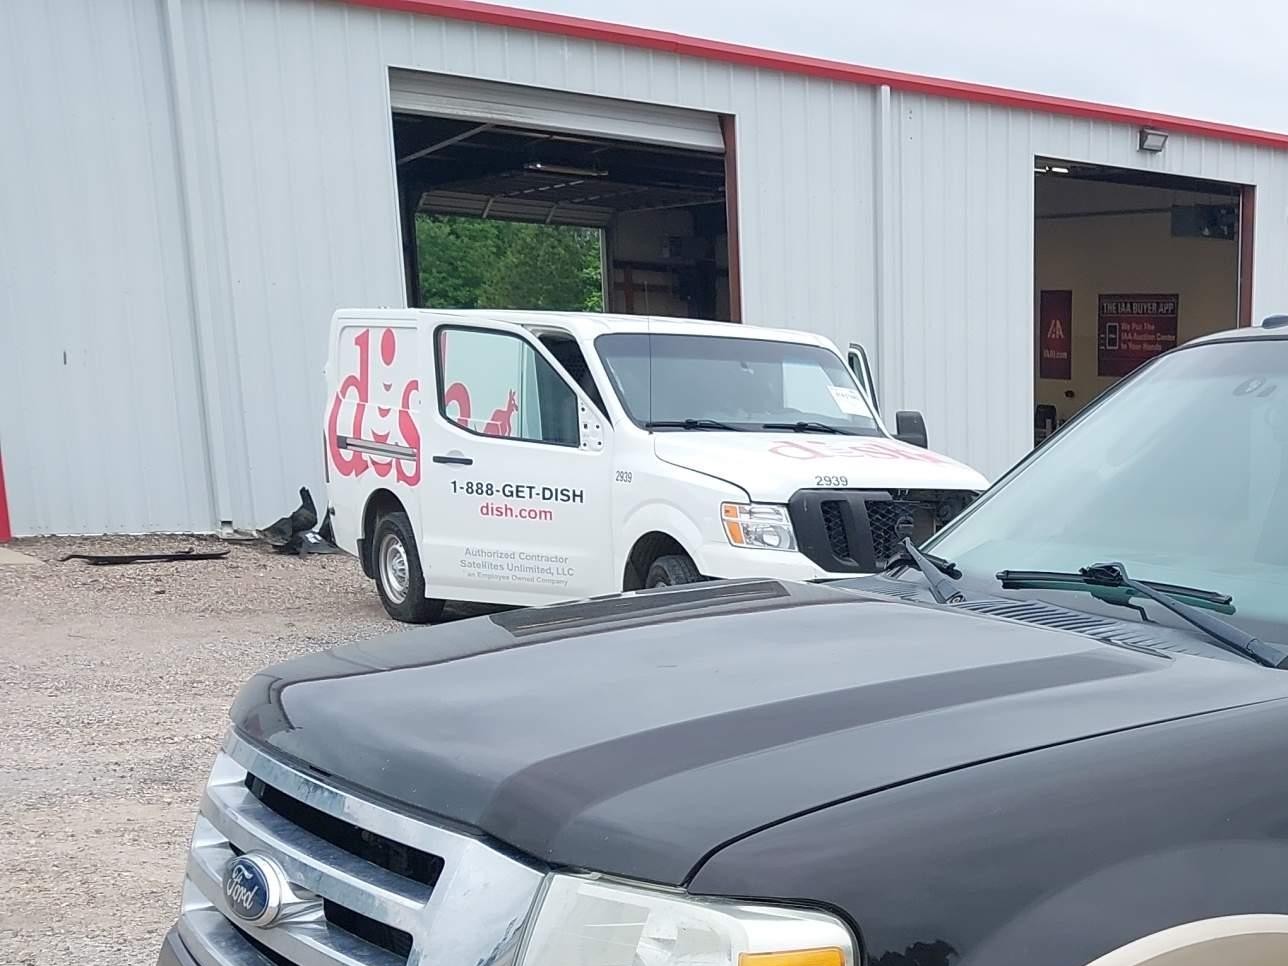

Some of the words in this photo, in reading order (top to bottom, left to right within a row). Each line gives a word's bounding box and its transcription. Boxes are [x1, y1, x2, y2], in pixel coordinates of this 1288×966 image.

[1104, 303, 1117, 313] THE
[1118, 303, 1131, 313] IAA
[1132, 303, 1157, 313] BUYER
[1158, 303, 1174, 313] APP
[615, 470, 633, 483] 2939
[815, 475, 848, 487] 2939
[451, 480, 584, 503] 1-888-GET-DISH
[480, 503, 553, 521] dish.com
[464, 547, 516, 560] Authorized
[518, 551, 569, 564] Contractor
[460, 560, 504, 571] Satellites
[506, 563, 554, 576] Unlimited,
[556, 567, 575, 577] LLC
[511, 575, 535, 583] Owned
[536, 577, 569, 587] Company
[226, 864, 259, 910] Ford
